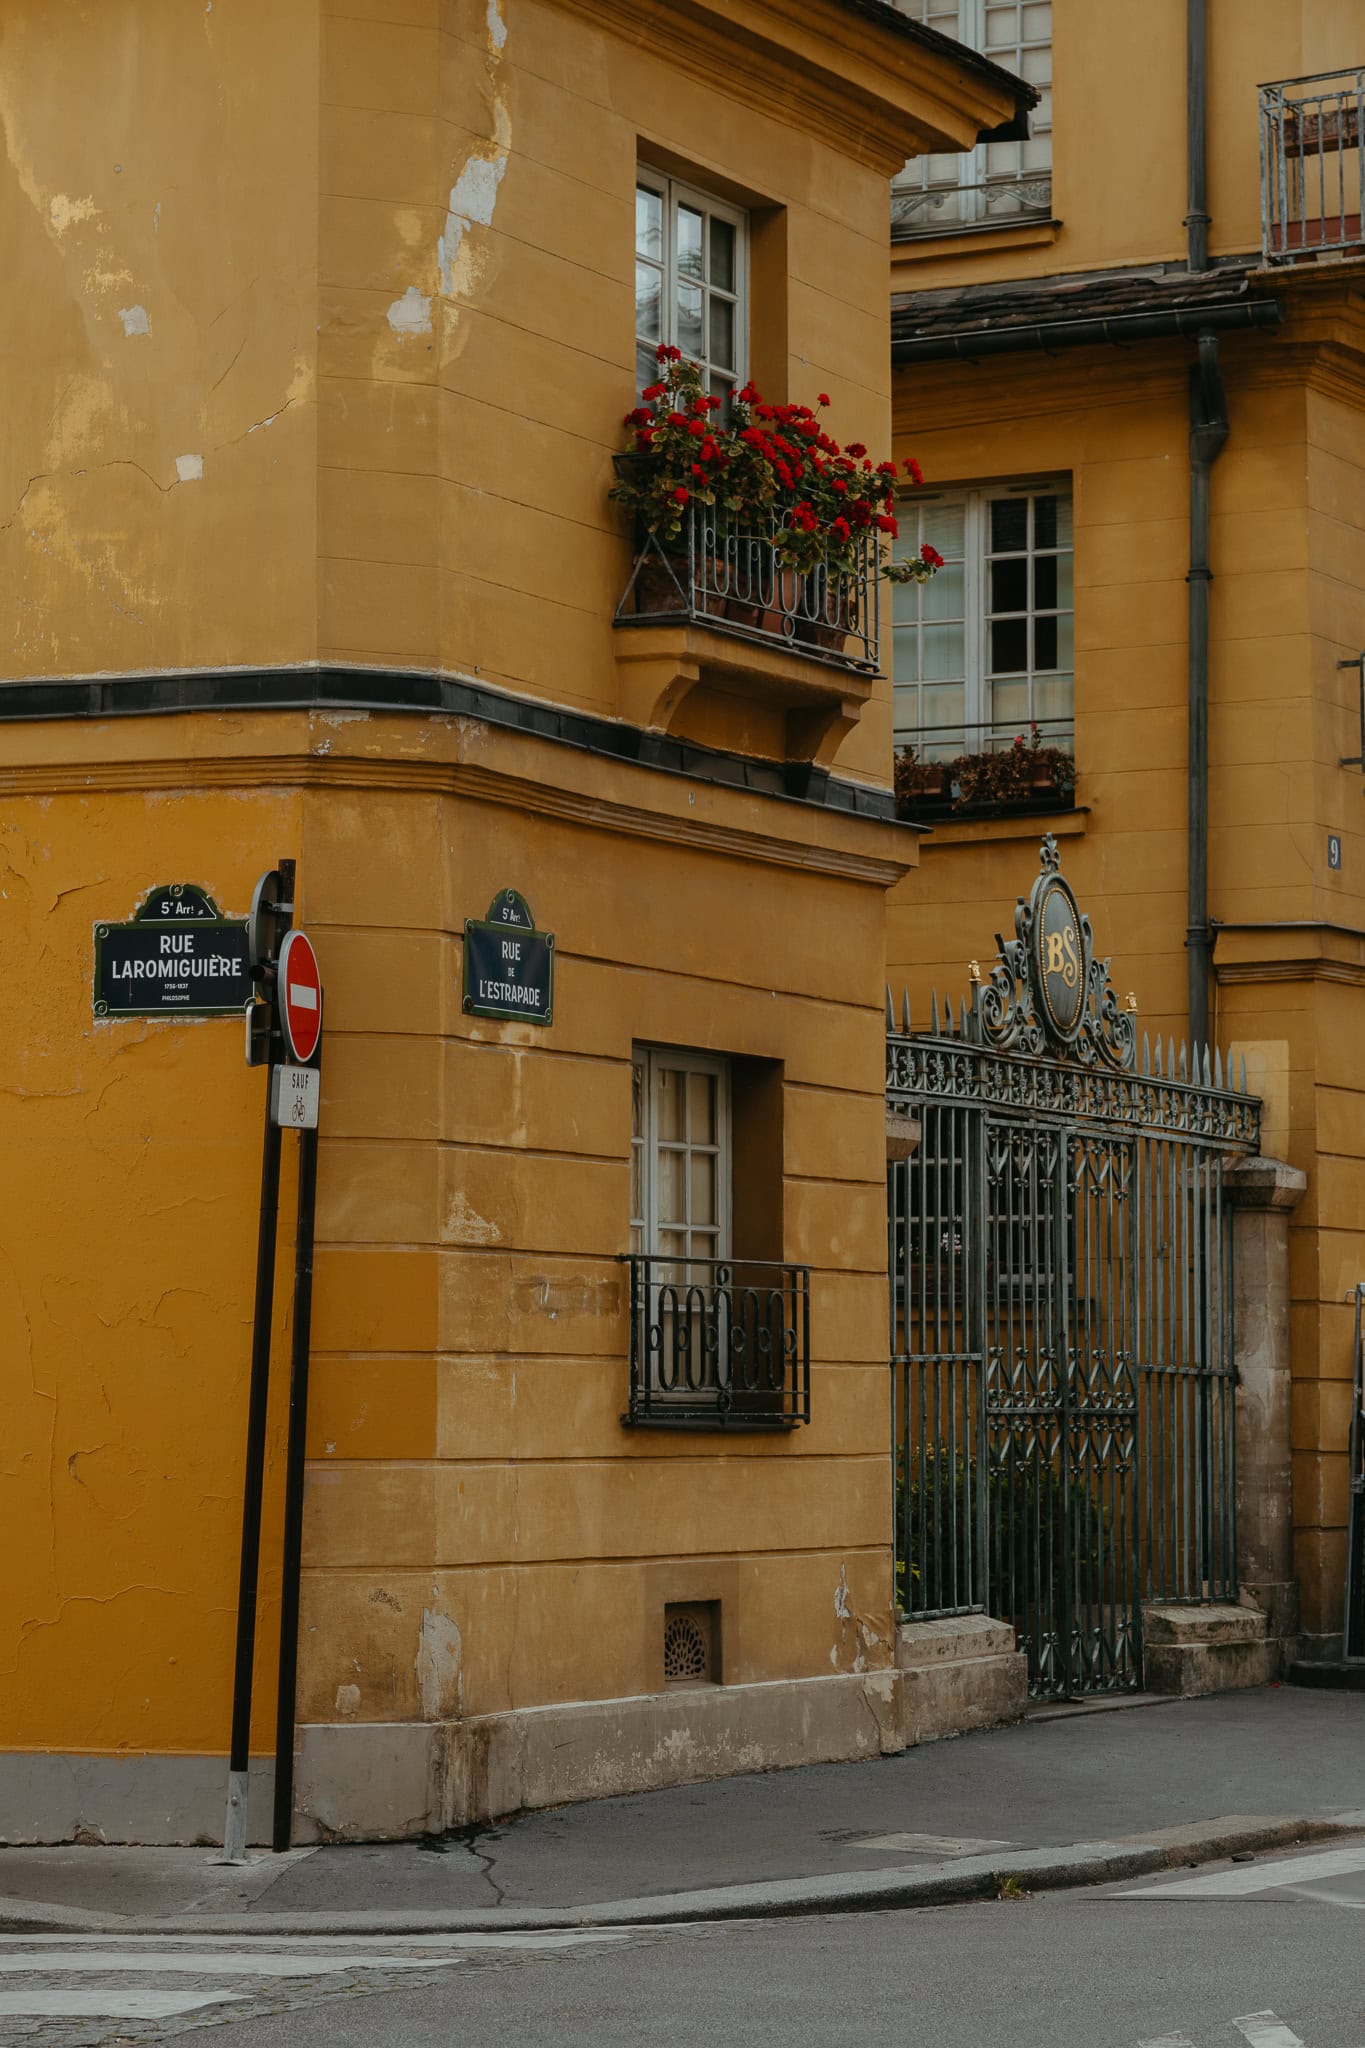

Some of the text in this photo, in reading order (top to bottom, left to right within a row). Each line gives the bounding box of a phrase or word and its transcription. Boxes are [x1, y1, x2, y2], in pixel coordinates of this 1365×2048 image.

[1330, 839, 1339, 865] 9
[160, 934, 194, 953] RUE
[501, 940, 521, 961] RUE
[112, 954, 242, 979] LAROMIGUIÈRE
[1045, 925, 1078, 988] BS
[507, 967, 515, 977] DE
[479, 979, 540, 1007] L'ESTRAPADE
[291, 1072, 309, 1089] SAUF
